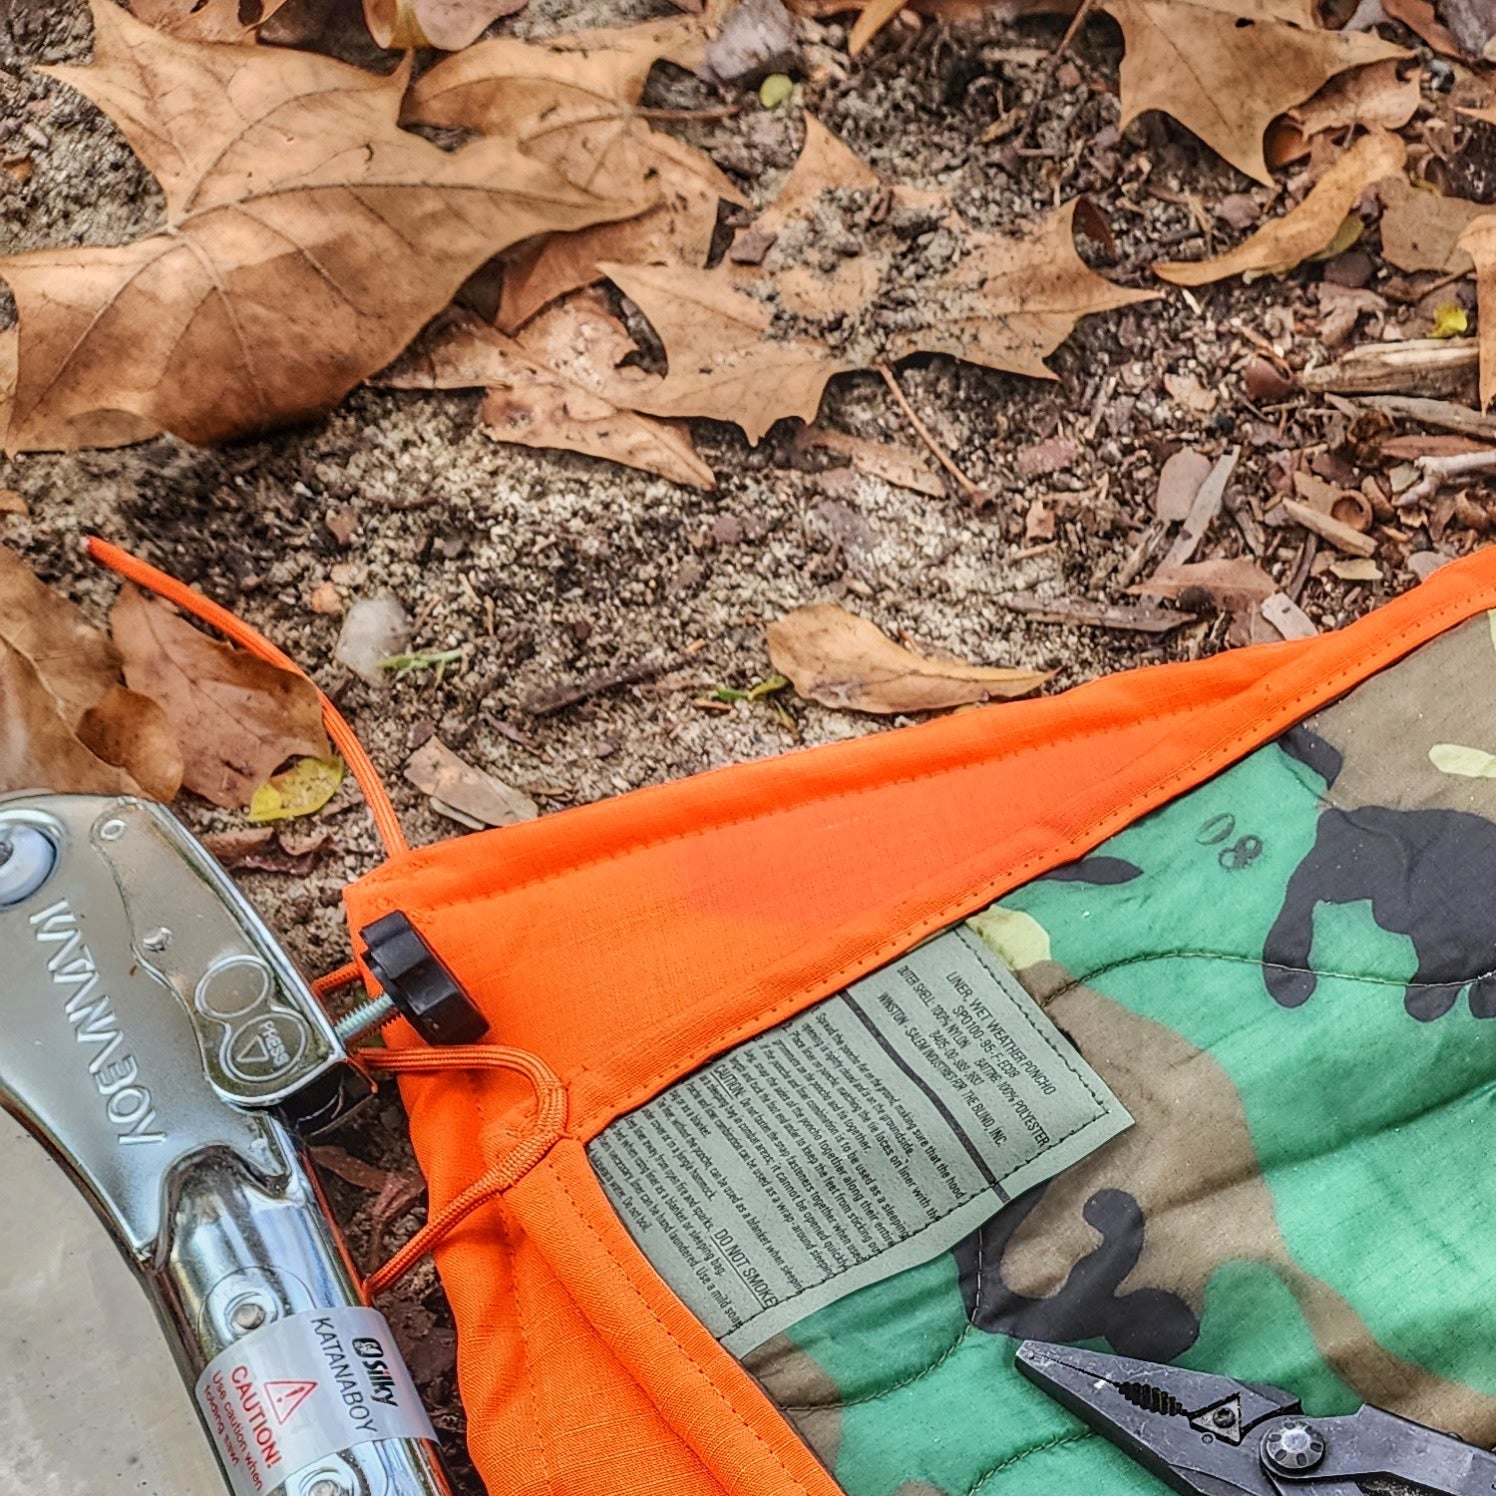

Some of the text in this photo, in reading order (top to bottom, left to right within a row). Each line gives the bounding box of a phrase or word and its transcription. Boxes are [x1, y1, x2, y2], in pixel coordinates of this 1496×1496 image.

[257, 1020, 291, 1069] PRESS
[944, 970, 1057, 1097] LINER, WET WEATHER PONCHO
[875, 990, 910, 1027] WINSTON
[902, 1024, 931, 1053] SALEM
[959, 1088, 981, 1108] THE
[970, 1100, 997, 1131] BLIND,
[987, 1125, 1008, 1148] INC.
[928, 1003, 953, 1029] 100%
[943, 1022, 971, 1051] NYLON
[995, 1078, 1020, 1103] 100%
[1010, 1098, 1050, 1148] POLYESTER
[833, 1131, 847, 1144] is
[839, 1139, 854, 1154] to
[841, 1115, 875, 1156] together.
[878, 1109, 919, 1159] groundside.
[891, 1101, 919, 1131] making
[911, 1127, 929, 1148] sure
[923, 1143, 943, 1165] that
[935, 1161, 953, 1179] the
[944, 1175, 967, 1200] hood
[712, 1062, 746, 1099] CAUTION:
[784, 1153, 818, 1194] fasteners
[807, 1188, 840, 1227] together
[830, 1220, 855, 1246] when
[845, 1240, 868, 1265] used
[744, 1156, 760, 1171] be
[769, 1161, 783, 1174] it
[845, 1149, 862, 1165] be
[853, 1161, 876, 1186] used
[857, 1107, 933, 1210] the tie laces on liner with
[716, 1175, 731, 1188] be
[750, 1165, 772, 1188] used
[763, 1185, 777, 1199] as
[774, 1168, 803, 1202] cannot
[794, 1135, 875, 1245] to keep the feet from sticking
[796, 1114, 826, 1143] poncho
[815, 1137, 850, 1179] together
[839, 1173, 867, 1204] along
[858, 1198, 881, 1224] their
[872, 1219, 899, 1249] entire
[867, 1183, 881, 1198] as
[663, 1195, 690, 1224] blanket
[722, 1183, 743, 1206] used
[733, 1201, 747, 1215] as
[793, 1197, 810, 1213] be
[875, 1195, 886, 1205] a
[681, 1220, 693, 1232] or
[745, 1215, 773, 1247] blanket
[773, 1199, 817, 1253] wrap-around
[800, 1208, 831, 1244] opened
[878, 1200, 913, 1242] sleeping
[653, 1211, 675, 1234] hand
[666, 1228, 702, 1271] laundered.
[693, 1265, 713, 1285] Use
[709, 1287, 731, 1310] mild
[685, 1227, 717, 1262] sleeping
[689, 1203, 718, 1233] sparks.
[712, 1226, 734, 1248] DO
[723, 1242, 752, 1272] NOT
[740, 1264, 779, 1308] SMOKE
[764, 1241, 787, 1267] when
[706, 1256, 729, 1278] bag.
[806, 1246, 839, 1282] sleeping
[309, 1316, 379, 1434] KATANABOY
[361, 1354, 399, 1408] Silky
[210, 1369, 265, 1491] Use caution when
[229, 1365, 283, 1469] CAUTION!
